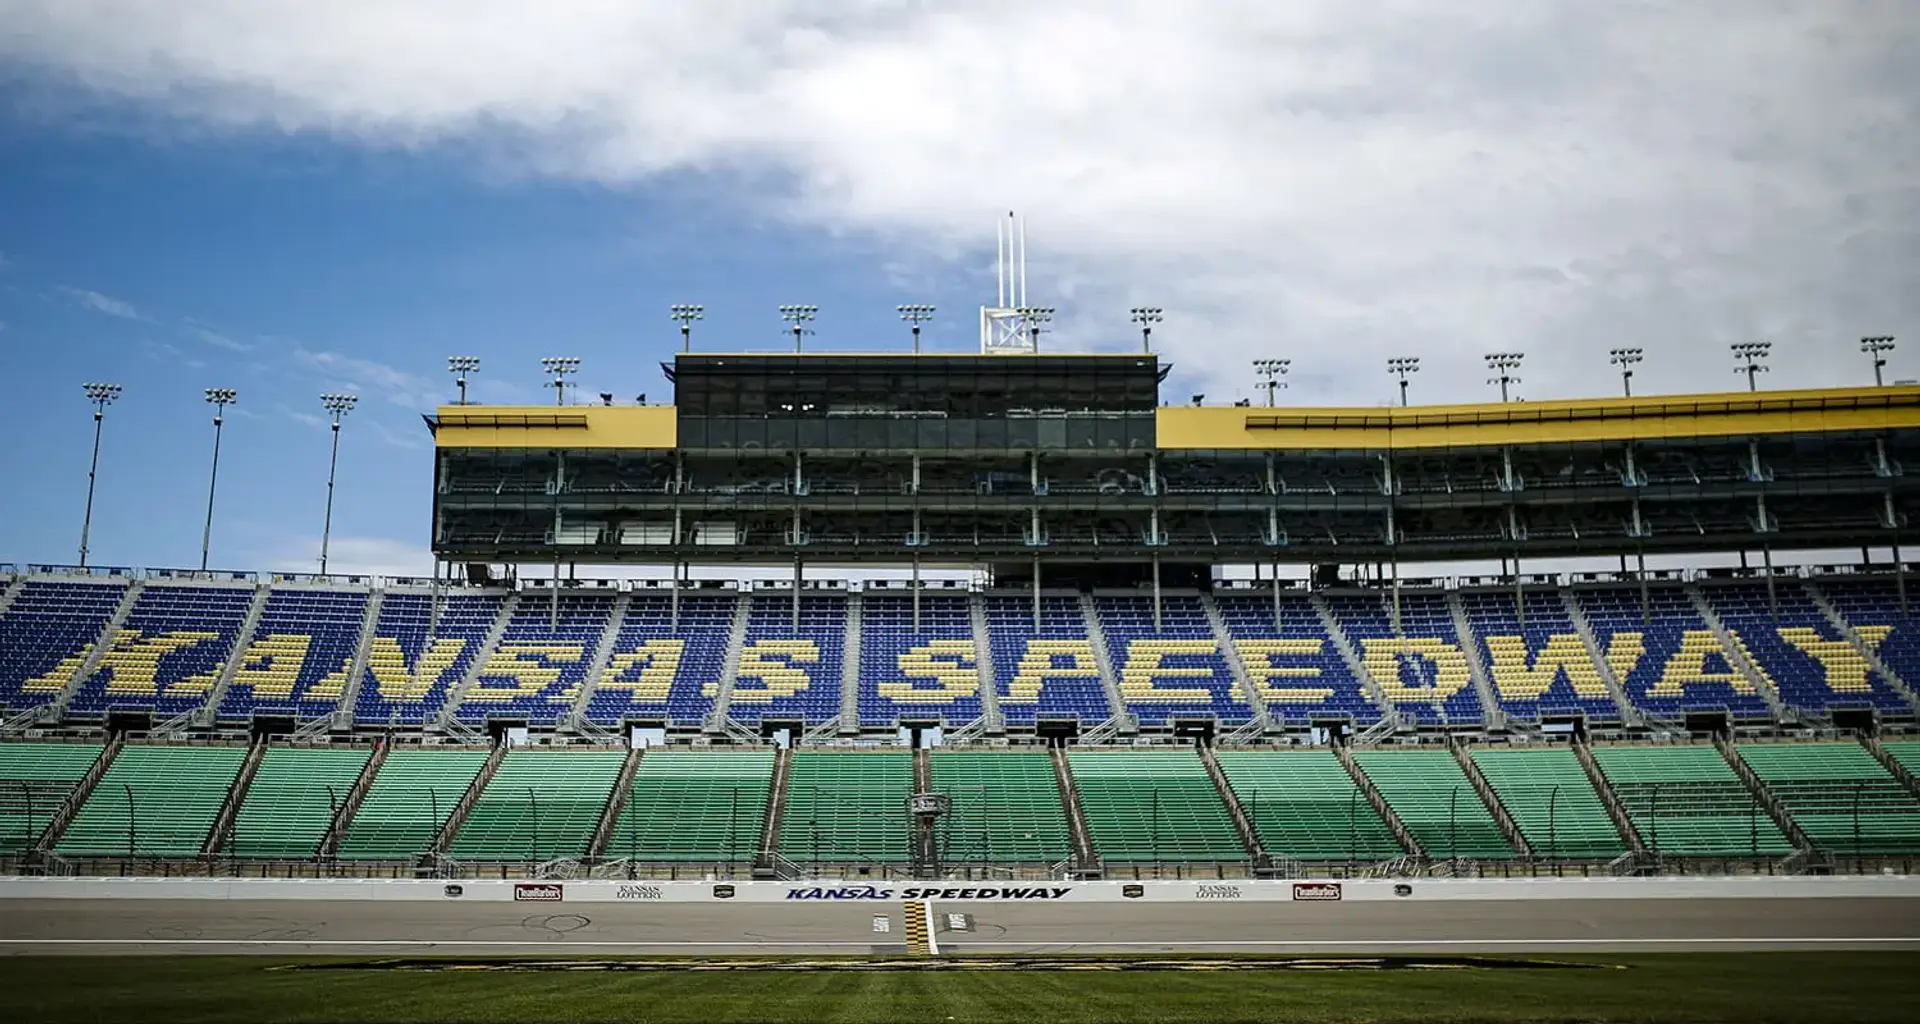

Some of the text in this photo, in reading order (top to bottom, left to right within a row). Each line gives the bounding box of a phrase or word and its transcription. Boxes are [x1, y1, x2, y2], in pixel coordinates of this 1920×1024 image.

[22, 625, 1895, 703] KANSAS SPEEDWAY
[786, 886, 1071, 899] KANSAS SPEEDWAY
